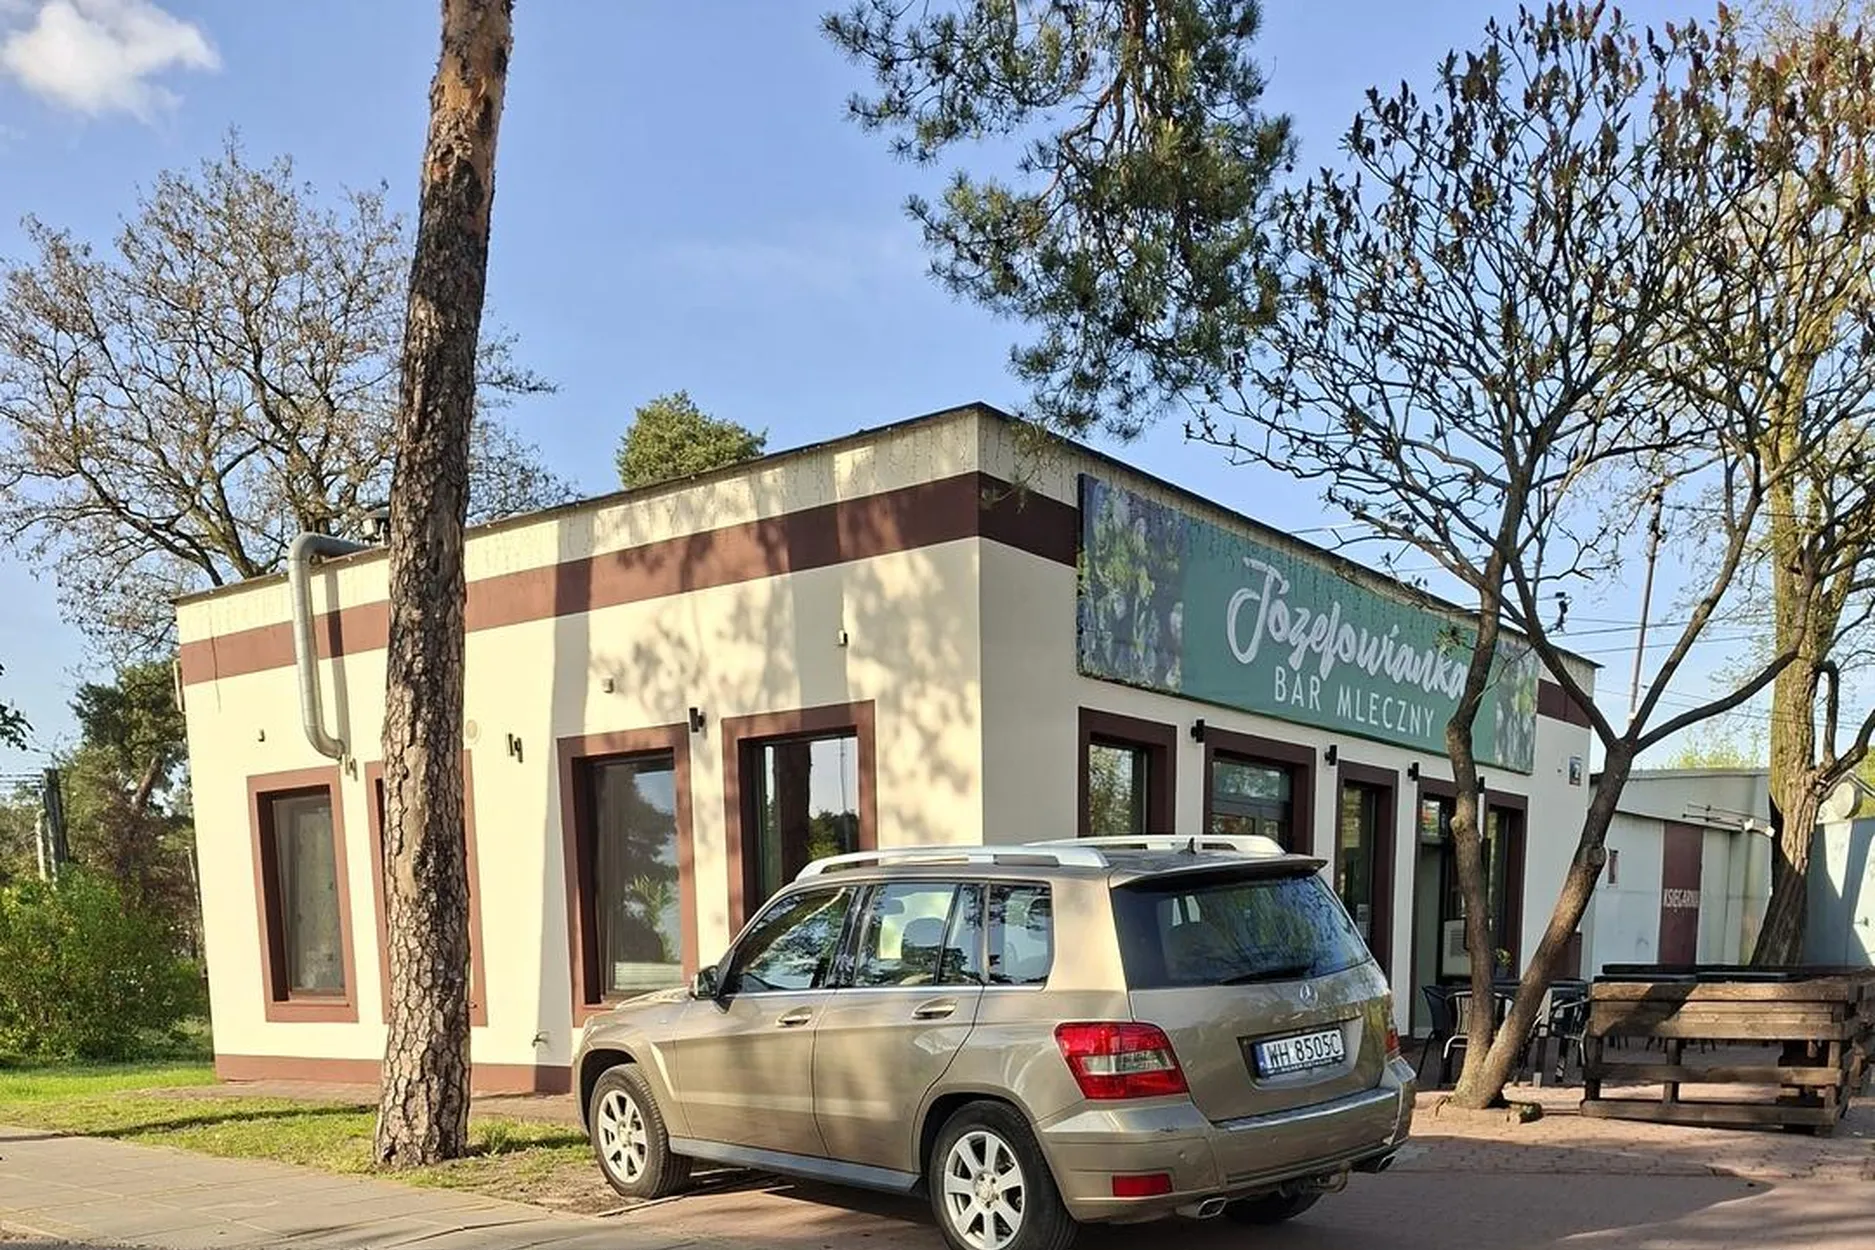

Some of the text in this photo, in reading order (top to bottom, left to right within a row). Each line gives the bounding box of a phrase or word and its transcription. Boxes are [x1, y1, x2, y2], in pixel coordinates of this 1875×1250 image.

[1227, 557, 1468, 699] Józefowianka
[1275, 665, 1435, 737] BAR MLECZNY
[1266, 1041, 1291, 1068] WH
[1294, 1033, 1341, 1062] 8505C
